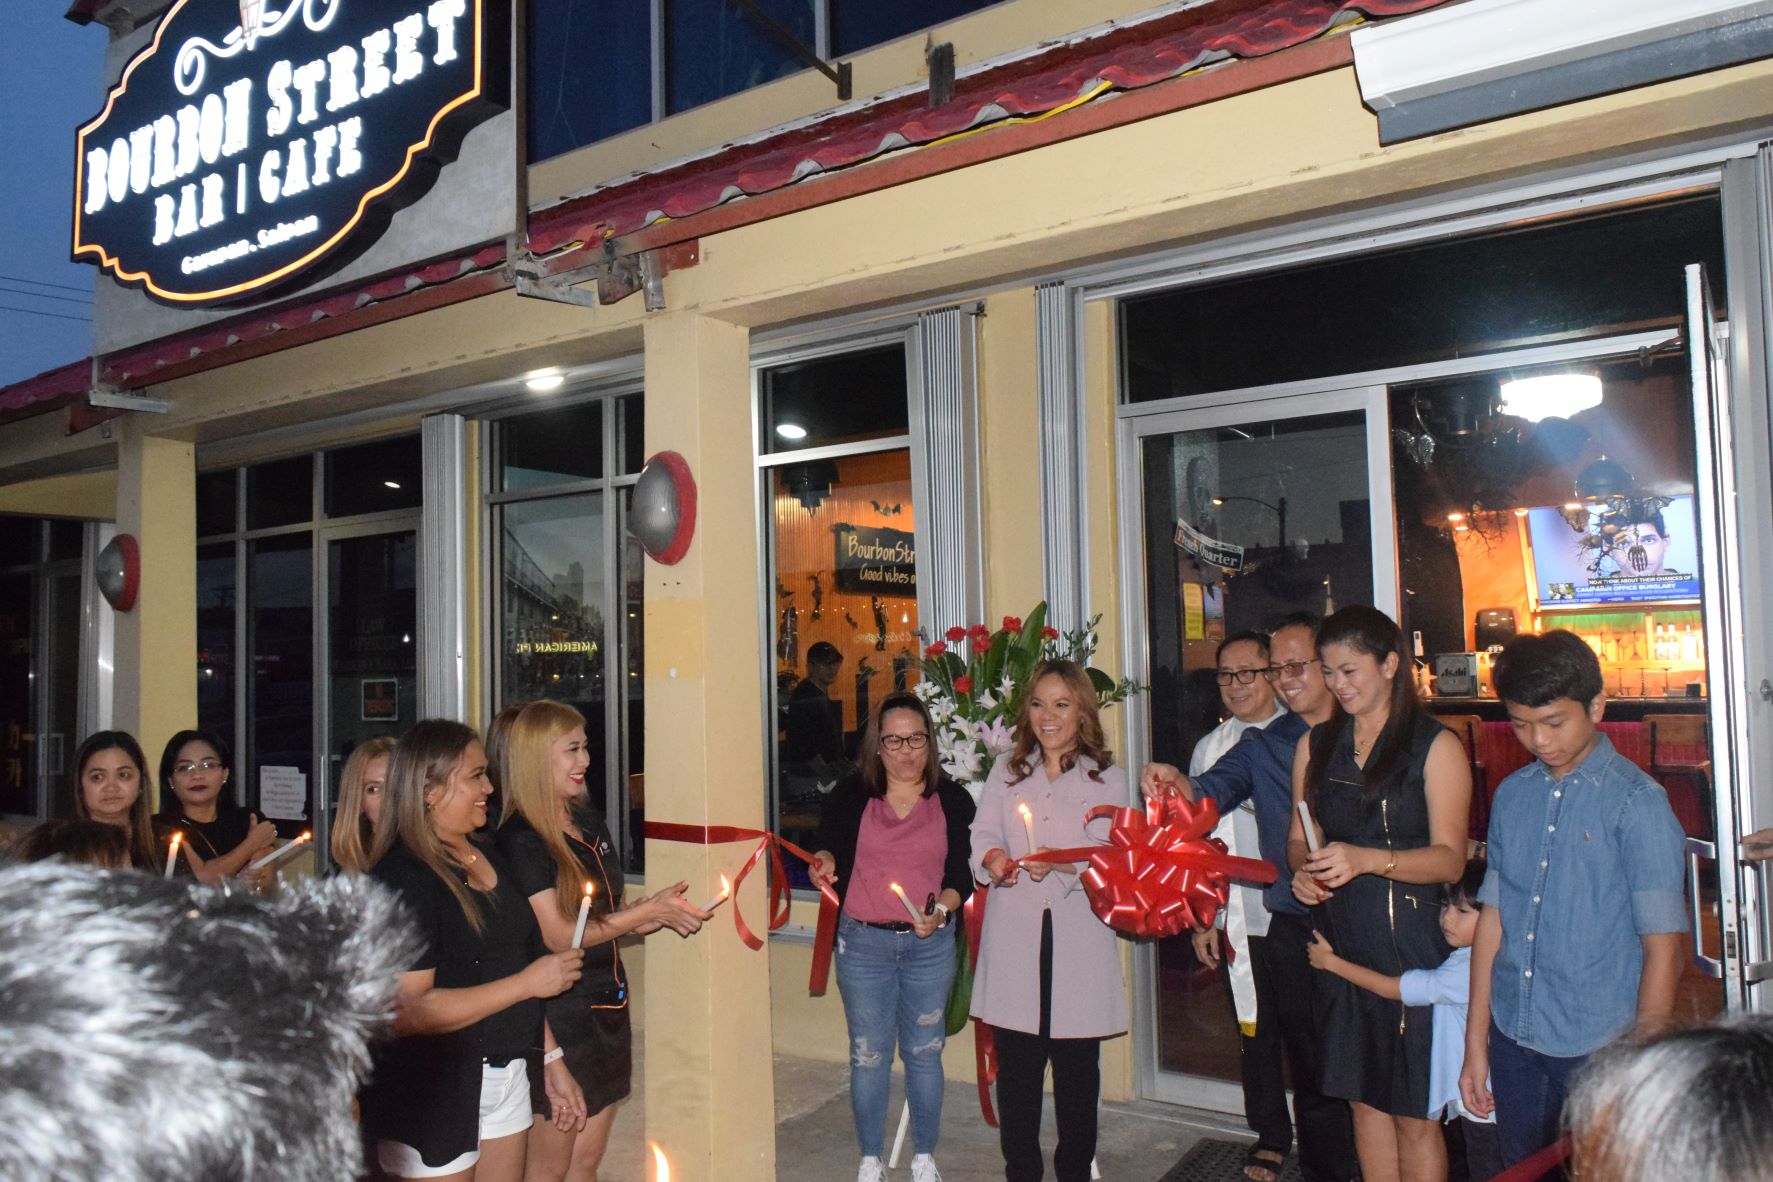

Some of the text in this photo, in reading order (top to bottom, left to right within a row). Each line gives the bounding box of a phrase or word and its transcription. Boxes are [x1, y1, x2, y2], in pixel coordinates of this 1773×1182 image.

[84, 0, 466, 215] BOURBON STREET
[152, 116, 362, 246] BAR CAFE
[1200, 543, 1238, 566] Quarter
[860, 562, 883, 581] Good
[884, 566, 909, 584] vibes
[1612, 584, 1638, 592] OFFICE
[1638, 583, 1677, 591] BURGLARY
